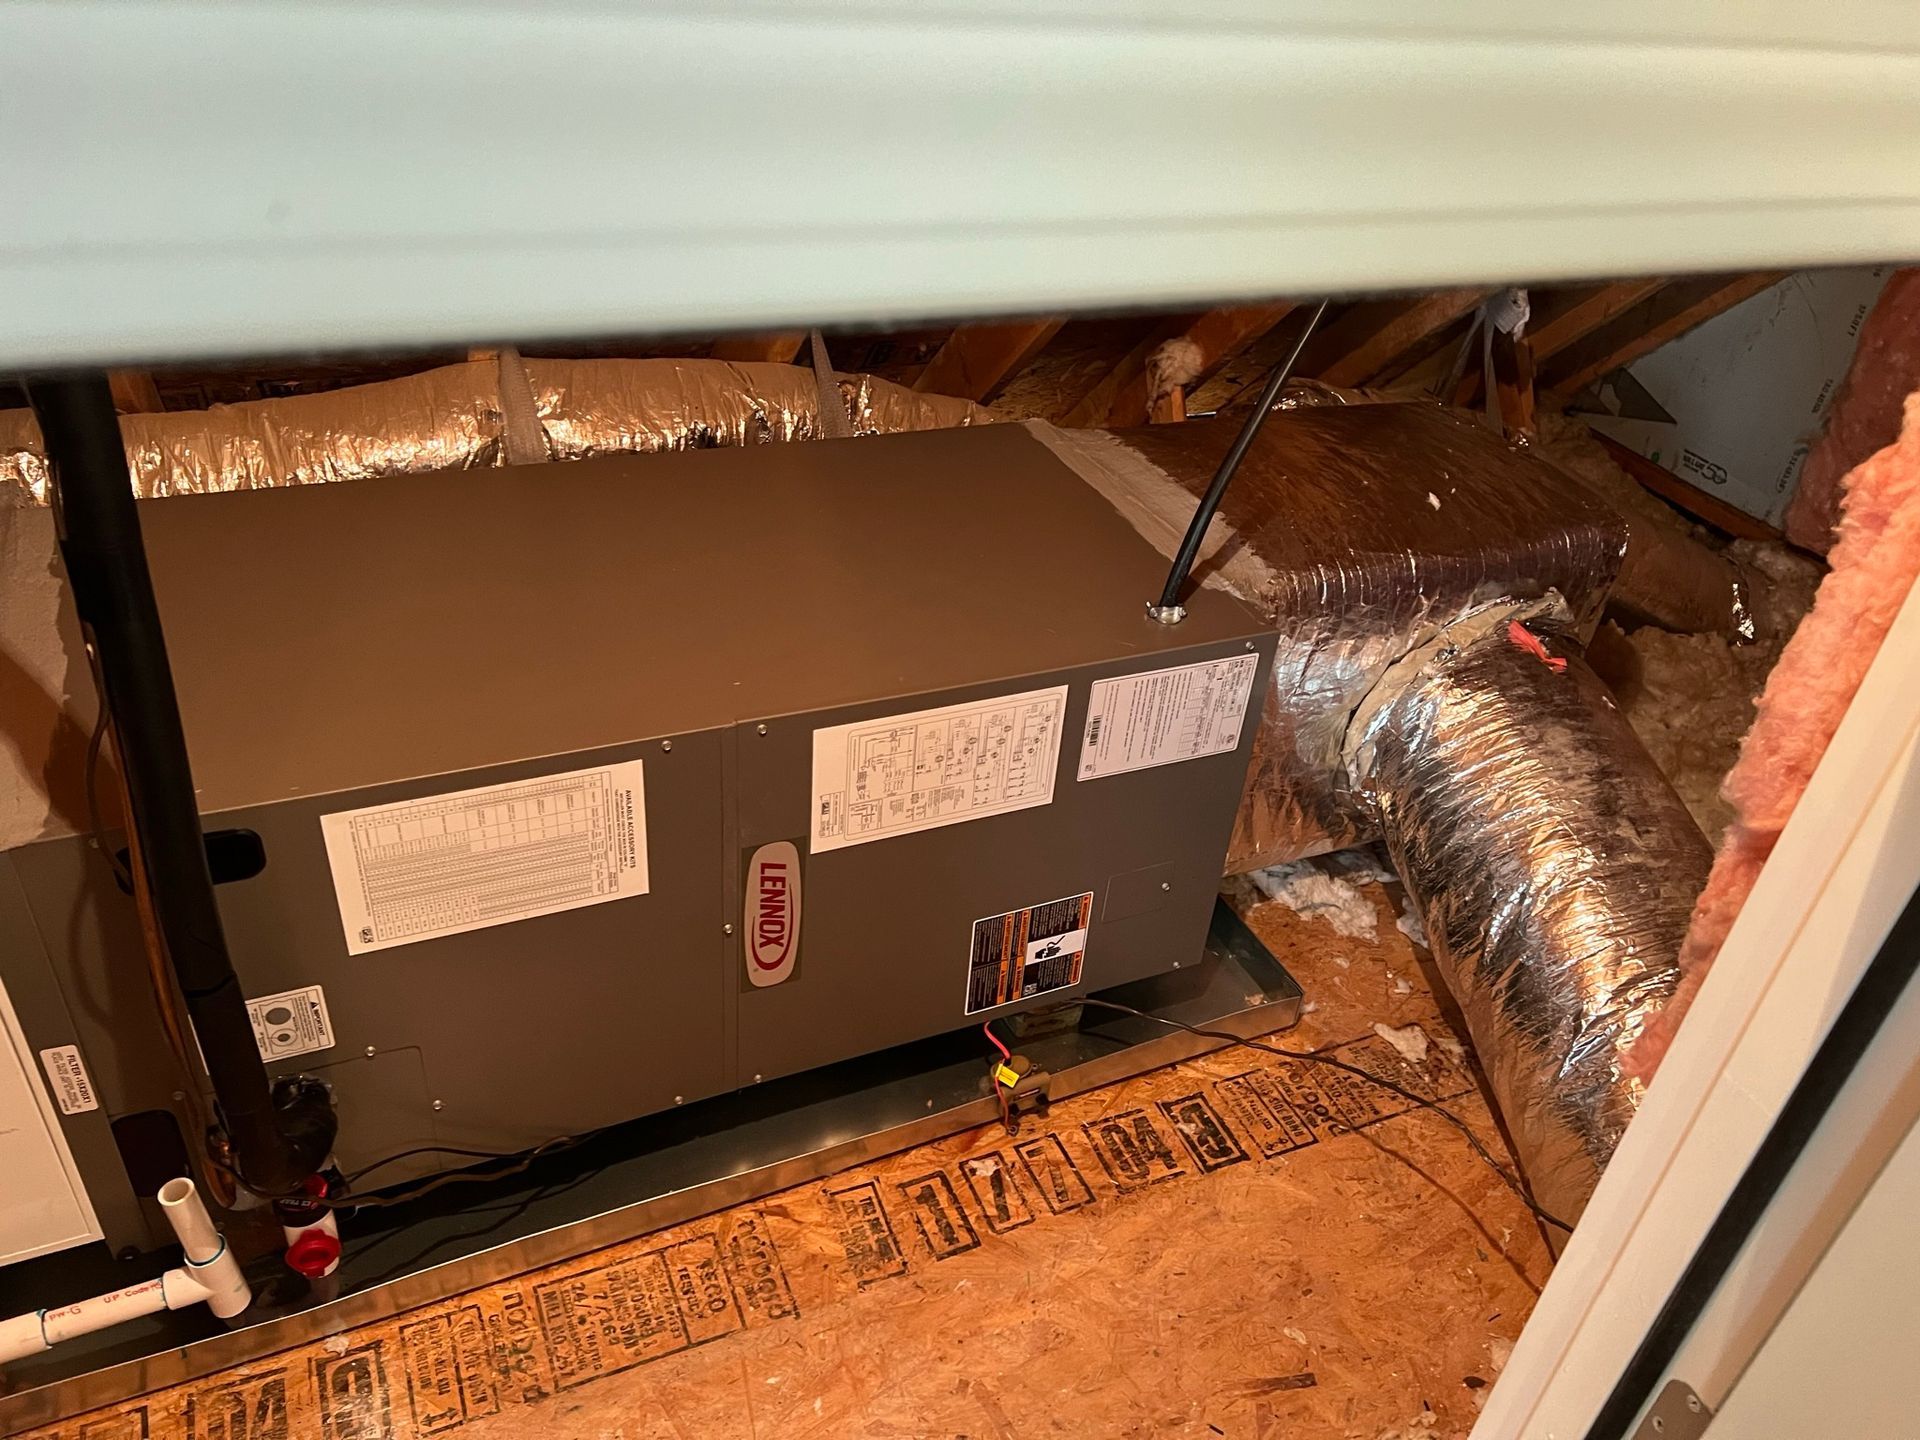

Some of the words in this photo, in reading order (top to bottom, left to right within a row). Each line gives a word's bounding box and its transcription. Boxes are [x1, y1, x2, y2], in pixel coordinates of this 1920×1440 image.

[624, 789, 632, 820] AVAILABLE
[759, 862, 786, 948] LENNOX
[312, 1008, 325, 1036] IMPORTANT
[65, 1053, 81, 1076] FILTER
[915, 1184, 959, 1246] 1
[1028, 1147, 1070, 1201] 7
[1099, 1116, 1178, 1180] 04
[735, 1218, 797, 1322] norbord
[124, 1284, 151, 1298] Code
[540, 1290, 560, 1323] MILL
[549, 1324, 567, 1350] NO.
